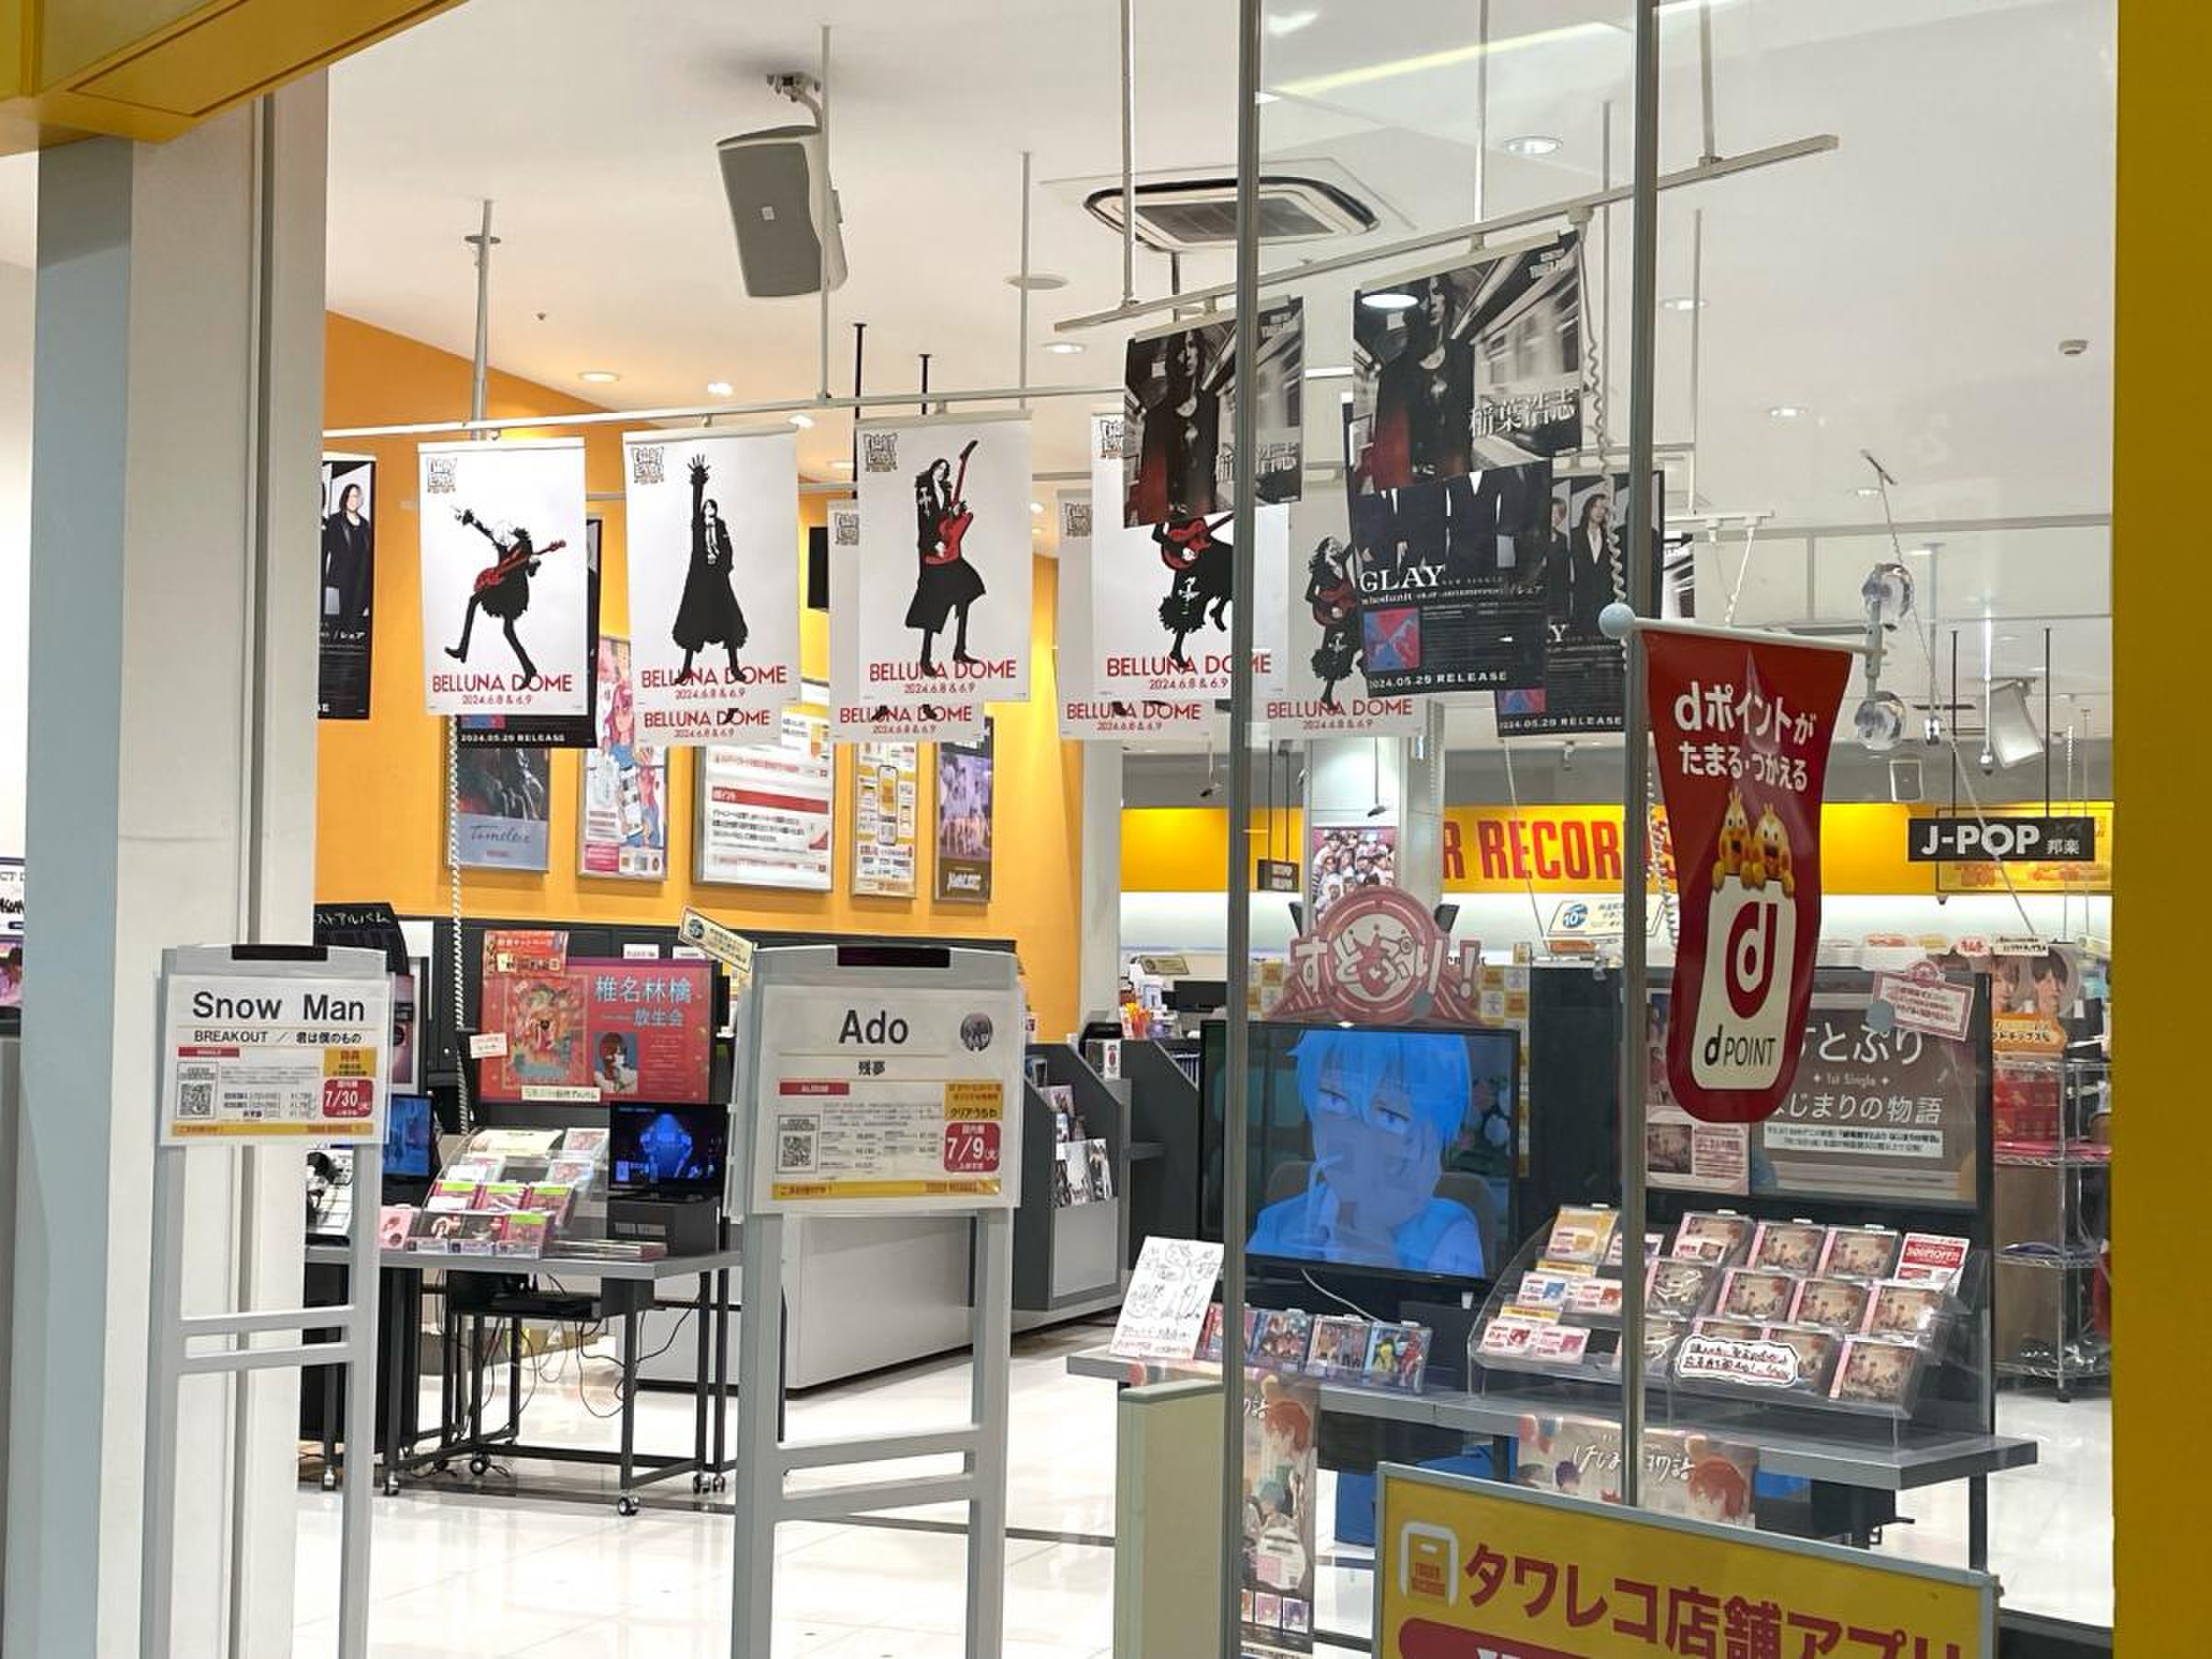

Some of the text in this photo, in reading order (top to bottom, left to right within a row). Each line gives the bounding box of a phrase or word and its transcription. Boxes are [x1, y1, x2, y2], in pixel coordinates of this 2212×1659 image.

[1359, 563, 1445, 593] GLAY
[1205, 653, 1271, 675] DOE
[1436, 671, 1508, 684] RELEASE
[432, 674, 572, 693] BELLUNA DOME
[1210, 677, 1229, 689] 6.9
[644, 708, 771, 728] BELLUNA DOME
[1267, 698, 1413, 719] BELLUNA DOME
[1675, 680, 1816, 746] dポイントが
[1478, 820, 1677, 880] RECOR
[1921, 824, 2080, 856] J-POP 邦楽
[594, 975, 692, 1004] 椎名林檎
[192, 991, 365, 1022] Snow Man
[194, 1030, 268, 1043] BREAKOUT
[839, 1009, 910, 1045] Ado
[1724, 1037, 1776, 1067] POINT
[324, 1089, 359, 1107] 7/30
[947, 1135, 984, 1162] 7/9
